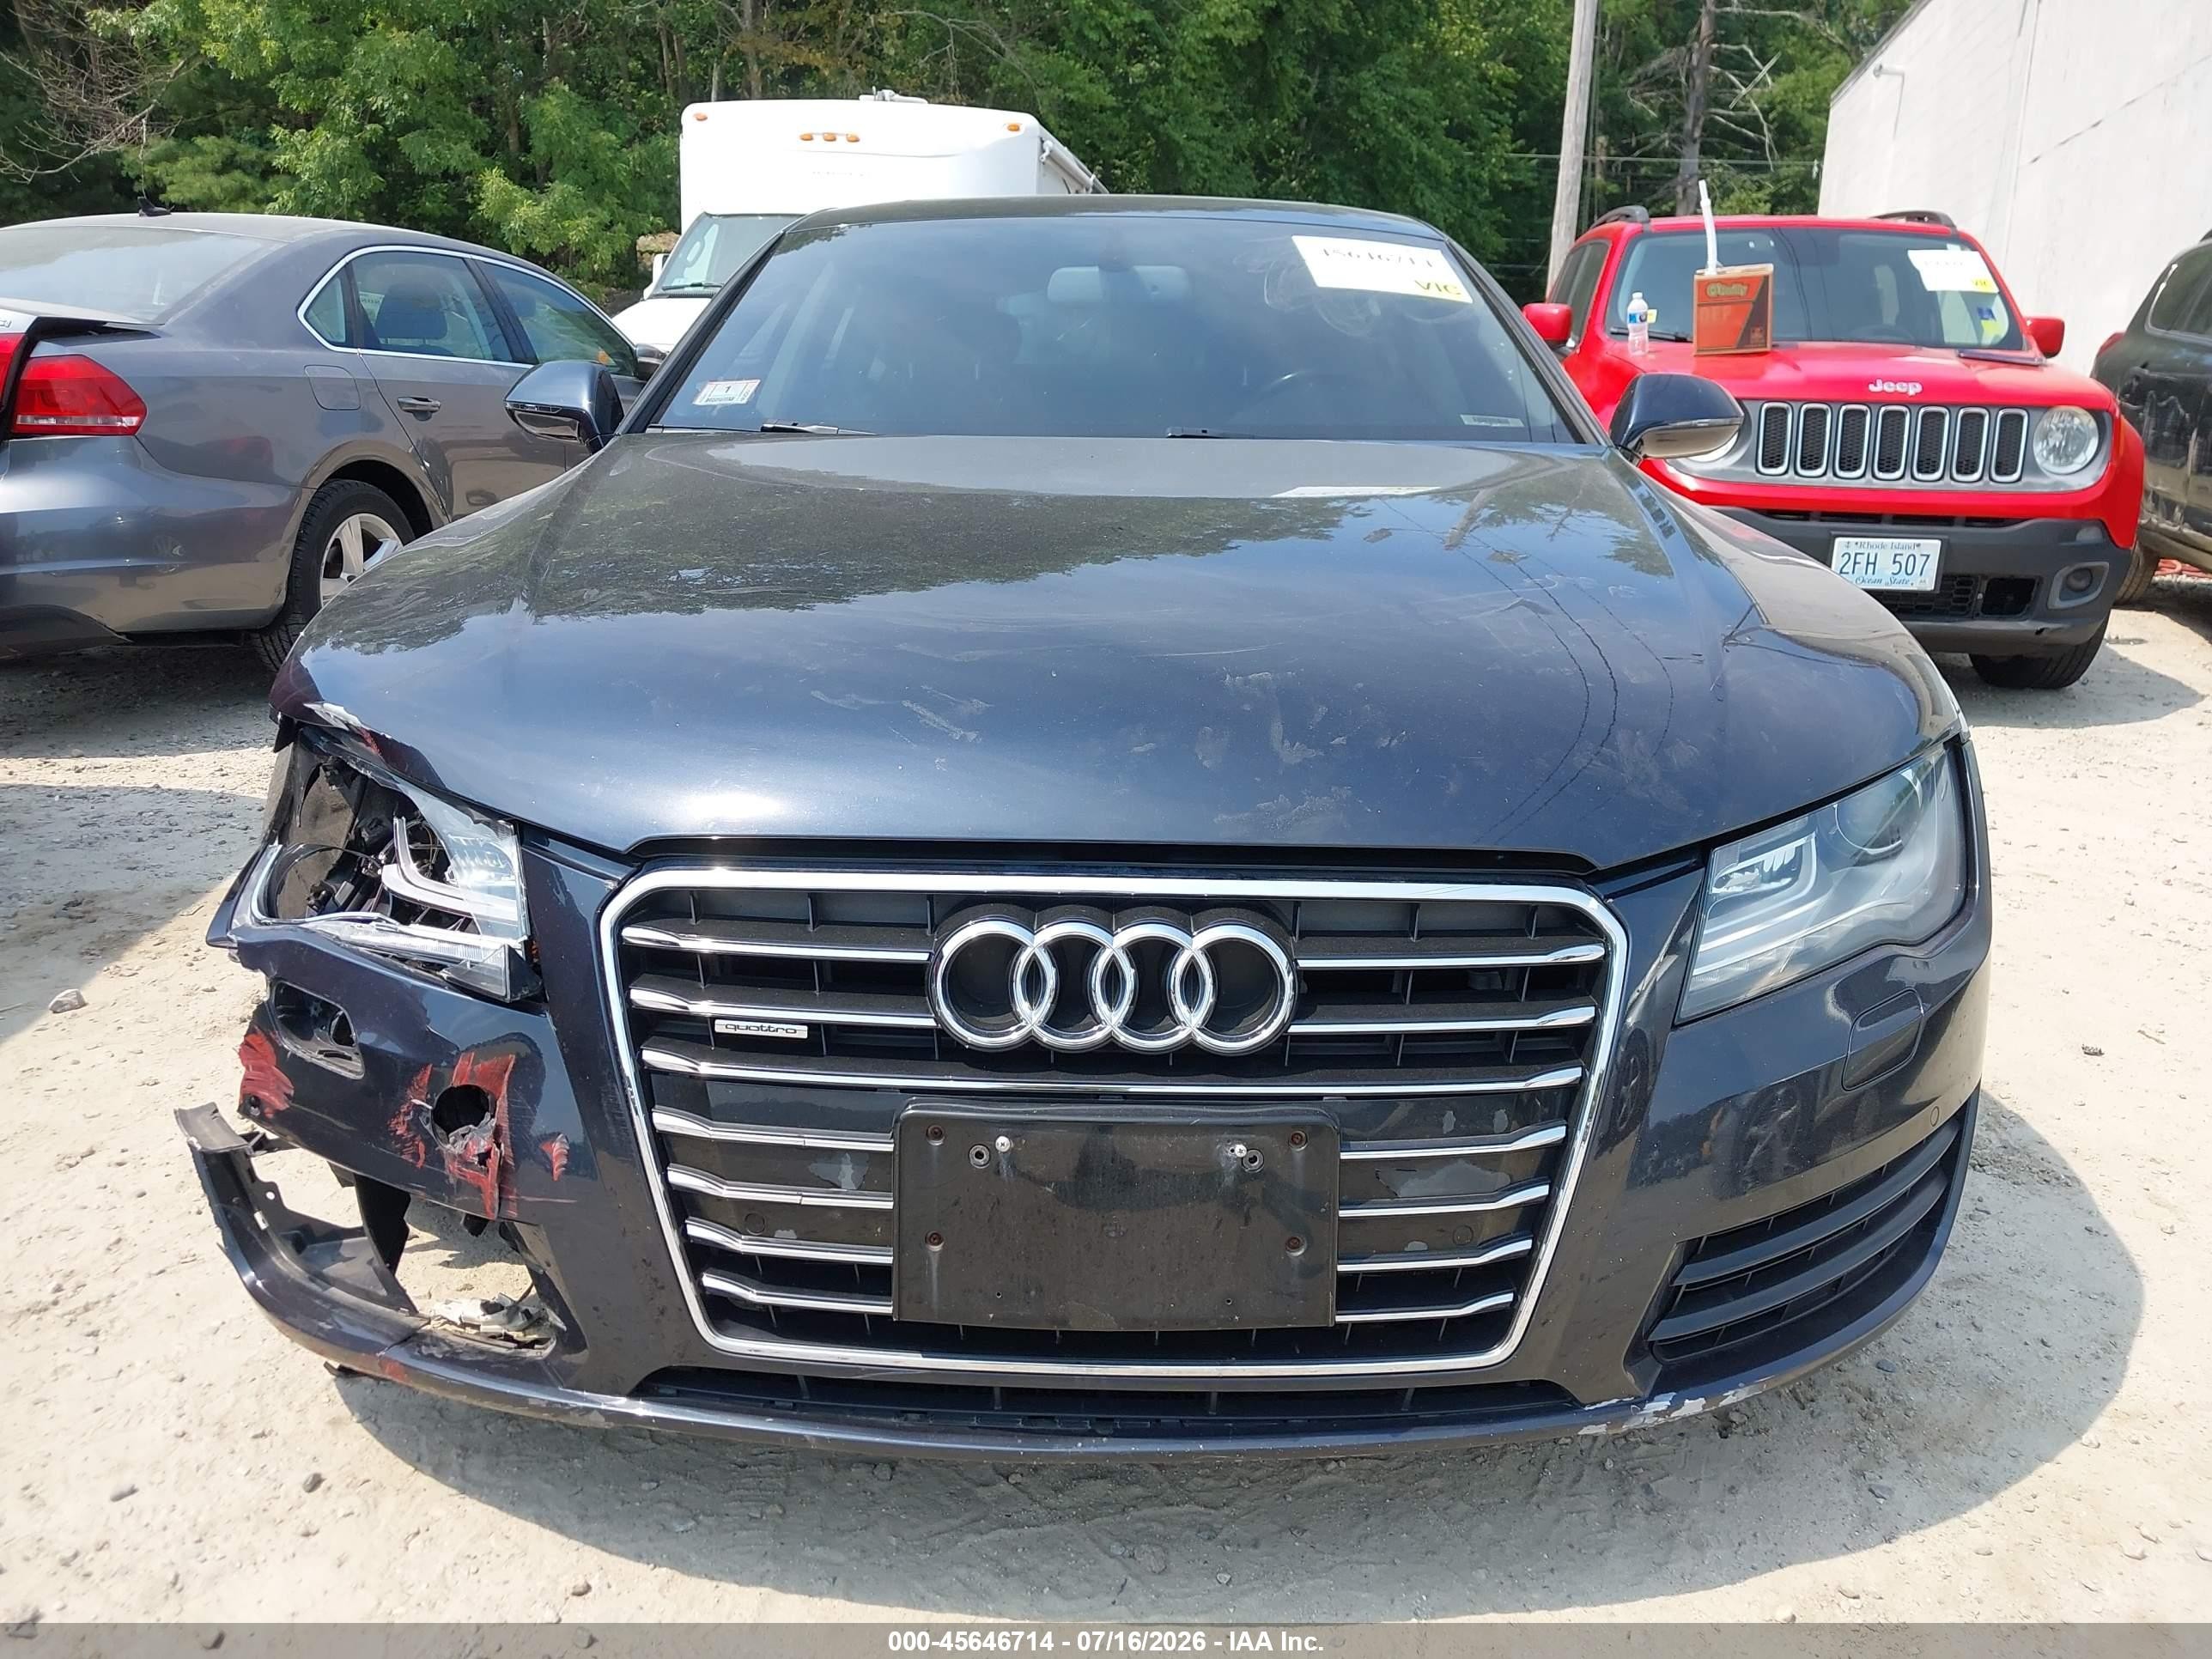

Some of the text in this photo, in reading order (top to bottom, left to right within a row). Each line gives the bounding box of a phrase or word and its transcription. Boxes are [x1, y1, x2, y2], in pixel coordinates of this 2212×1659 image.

[1414, 279, 1462, 295] VIC
[1868, 379, 1923, 396] Jeep
[1859, 541, 1917, 550] Rhode Island
[1839, 552, 1930, 576] 2FH 507
[1855, 576, 1882, 585] Ocean
[1887, 576, 1911, 586] State
[725, 1023, 797, 1034] quattro
